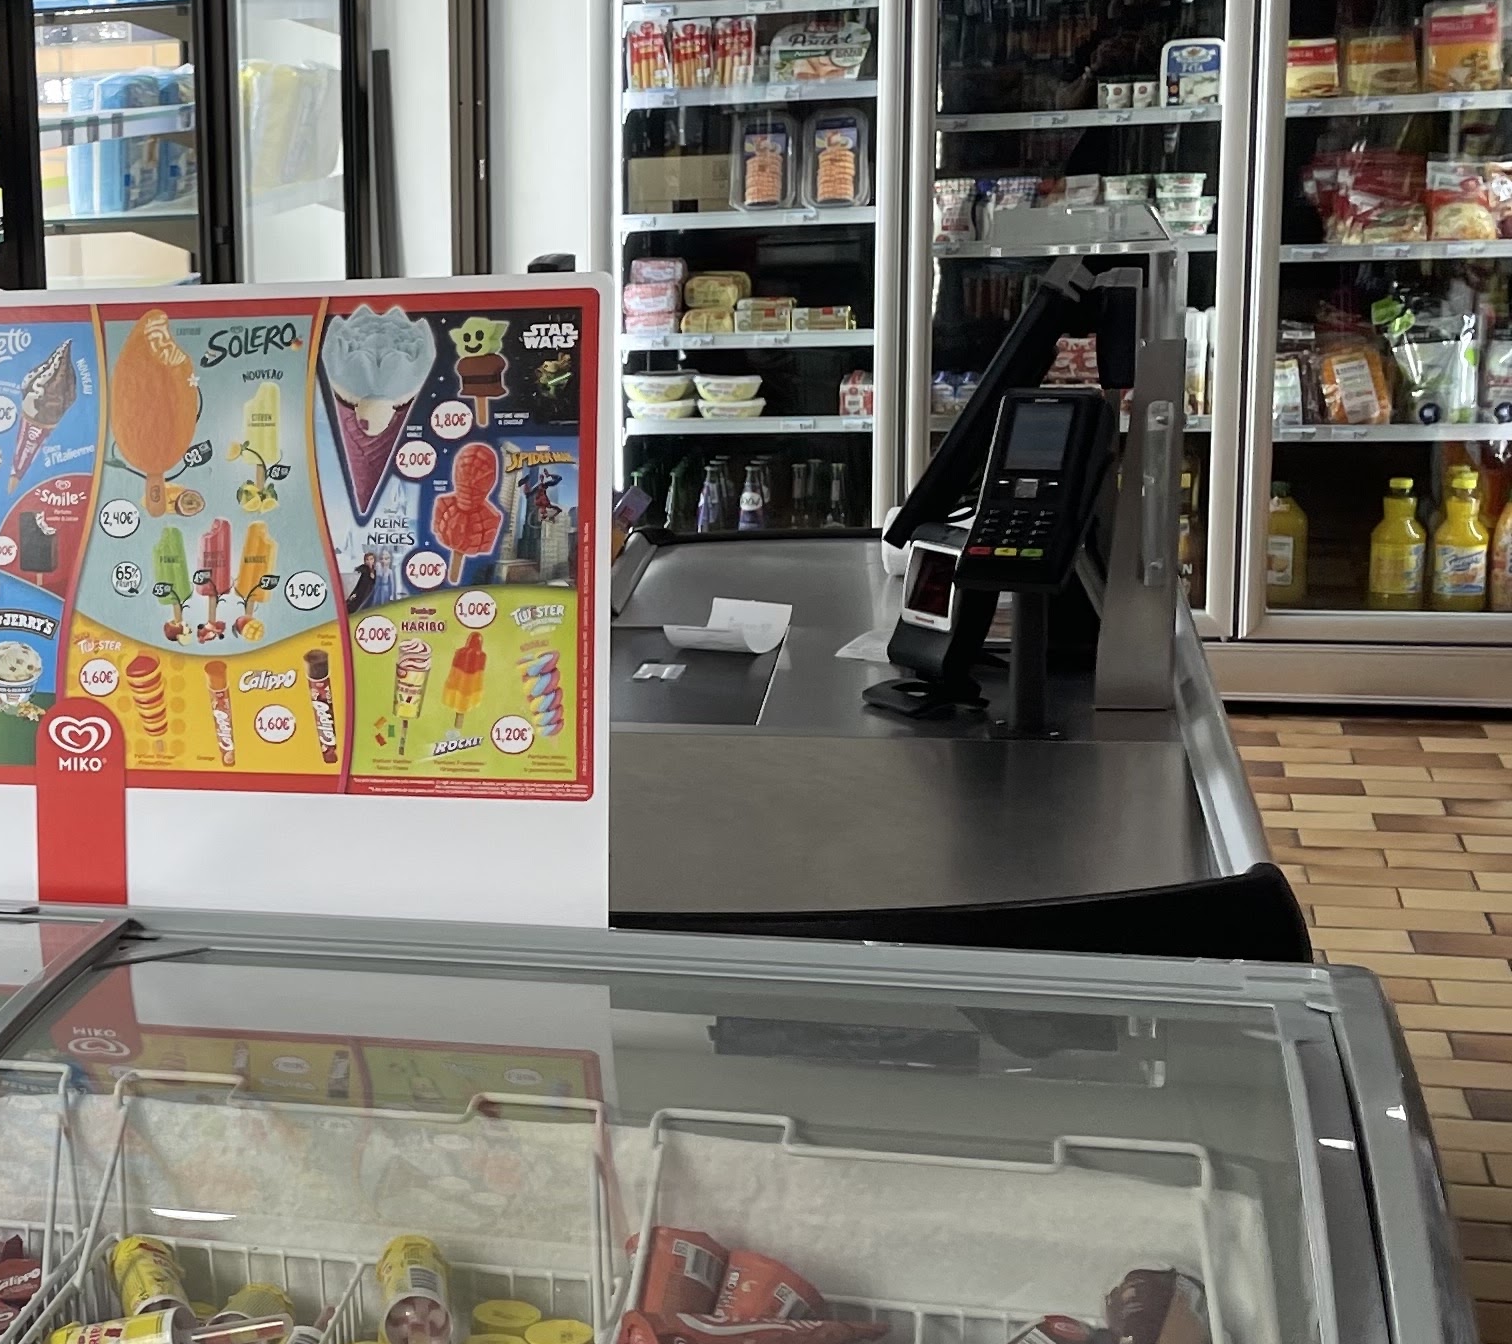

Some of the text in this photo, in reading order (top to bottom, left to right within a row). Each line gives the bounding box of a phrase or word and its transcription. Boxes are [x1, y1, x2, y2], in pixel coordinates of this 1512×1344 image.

[522, 322, 579, 337] STAR
[200, 322, 297, 368] SOLERO
[522, 336, 579, 350] WARS
[75, 357, 94, 396] NOUVEAU
[241, 367, 285, 384] NOUVEAU
[40, 489, 79, 507] Smile
[373, 517, 410, 530] REINE
[366, 532, 416, 546] NEIGES
[400, 620, 446, 633] HARIBO
[239, 668, 297, 694] Calippo
[58, 756, 103, 773] MIKO
